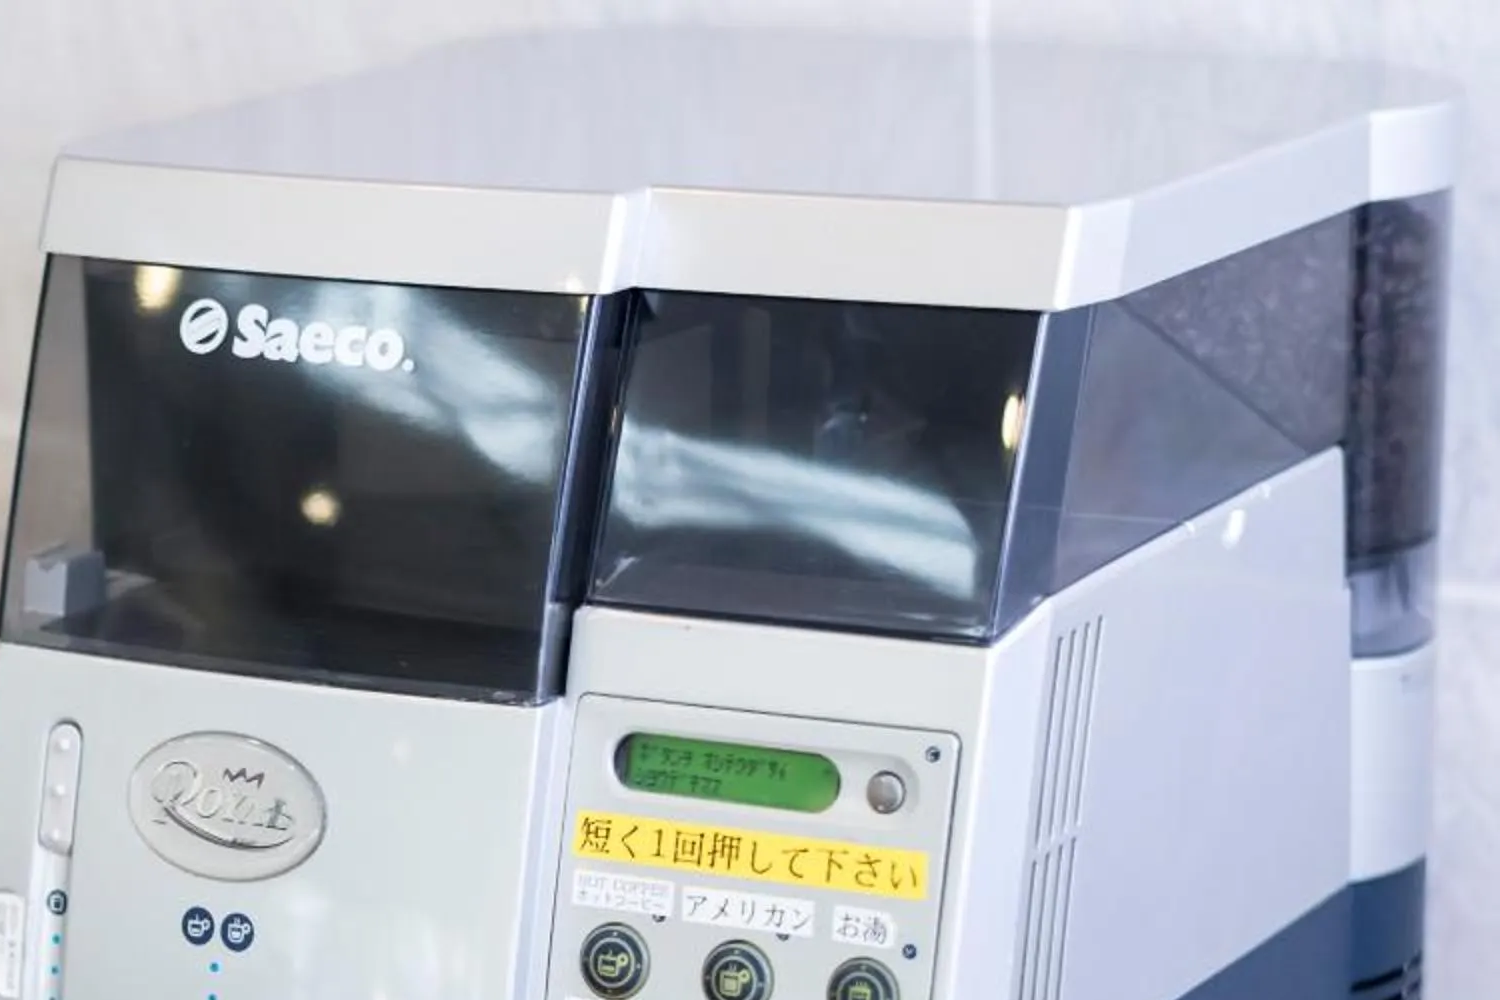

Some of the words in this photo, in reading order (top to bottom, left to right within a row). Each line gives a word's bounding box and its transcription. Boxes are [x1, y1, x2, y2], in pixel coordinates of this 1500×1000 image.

[580, 817, 918, 890] 短く1回押して下さい
[684, 893, 815, 931] アメリカン
[838, 913, 888, 945] お湯
